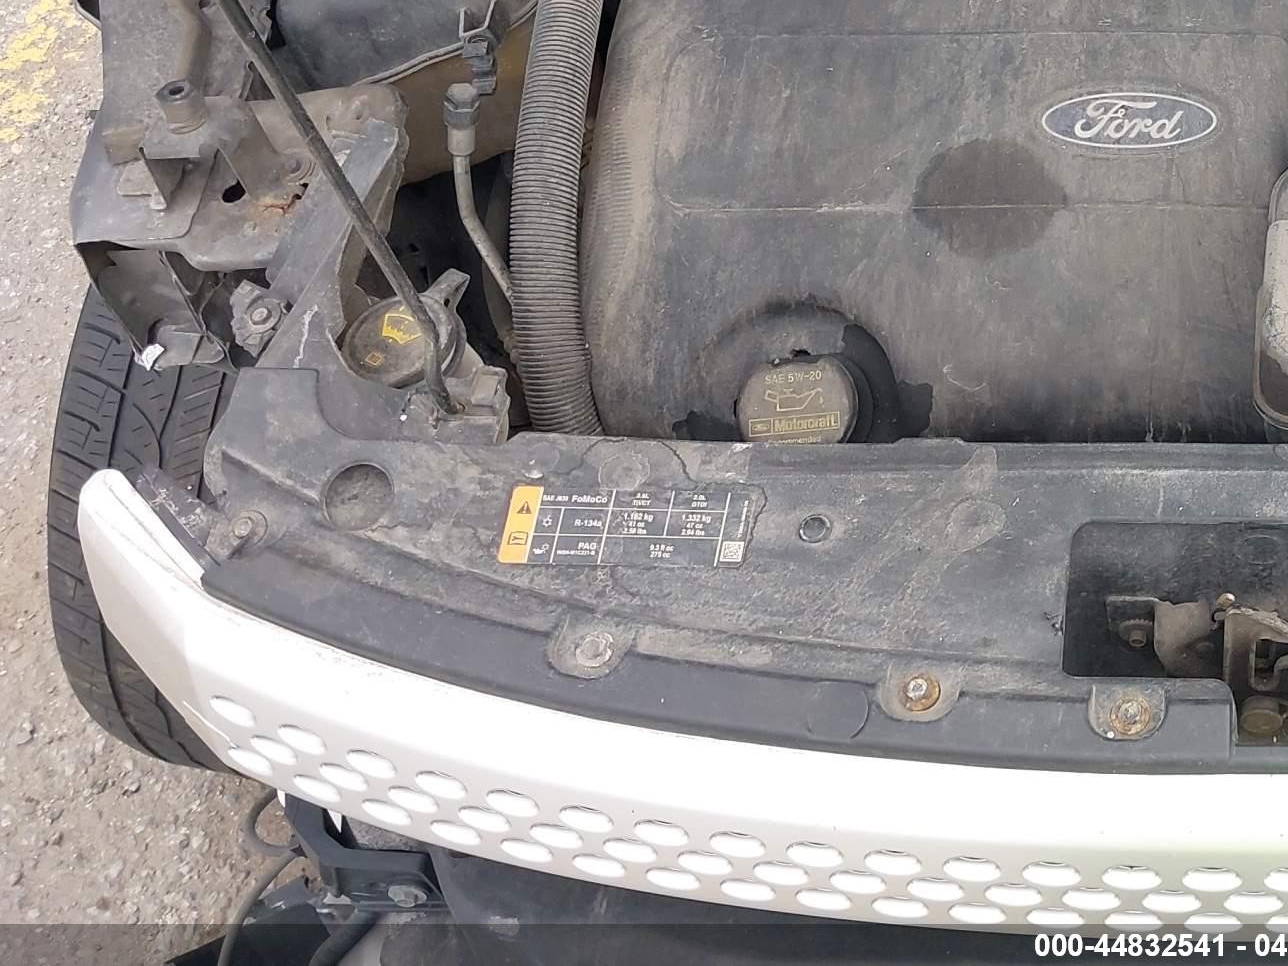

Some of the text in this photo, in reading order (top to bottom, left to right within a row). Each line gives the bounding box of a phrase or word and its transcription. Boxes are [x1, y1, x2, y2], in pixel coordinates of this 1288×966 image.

[1074, 99, 1185, 139] Ford
[764, 369, 822, 385] SAE 5W-20
[774, 414, 838, 432] Motorcraft
[571, 494, 608, 504] FoMoCo
[644, 512, 654, 522] kg
[682, 514, 712, 524] 1.332 kg
[574, 519, 603, 527] R-134a
[577, 542, 597, 550] PAG
